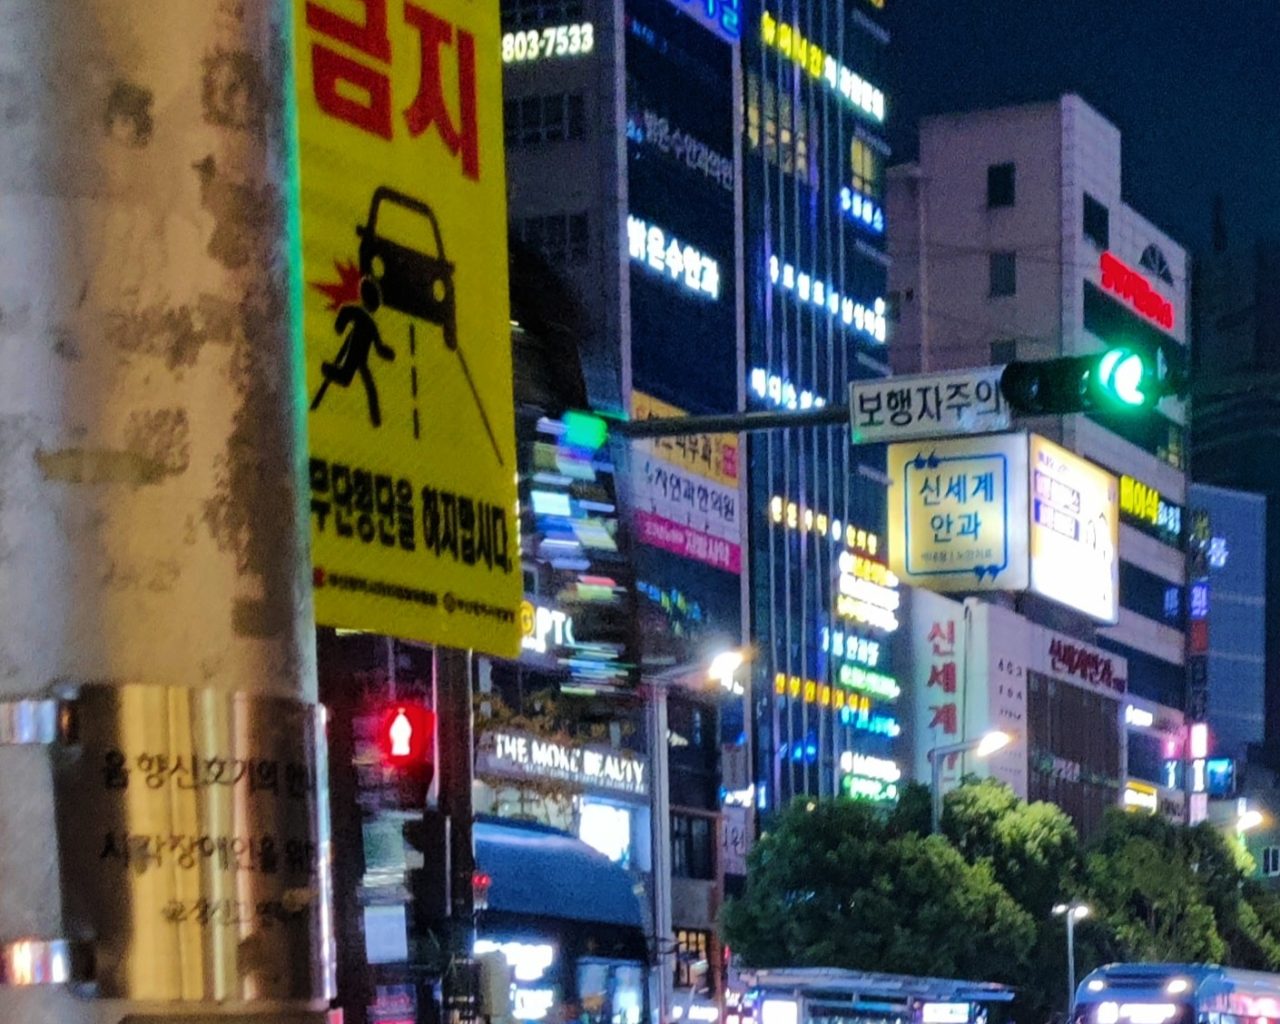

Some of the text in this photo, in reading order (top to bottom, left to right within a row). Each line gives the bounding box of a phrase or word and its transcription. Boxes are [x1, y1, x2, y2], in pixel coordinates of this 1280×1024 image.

[502, 22, 594, 63] 803-7533
[858, 378, 1001, 427] 보행자주의
[309, 457, 416, 552] 무단횡단을
[920, 471, 994, 506] 신세계
[930, 512, 982, 544] 안과
